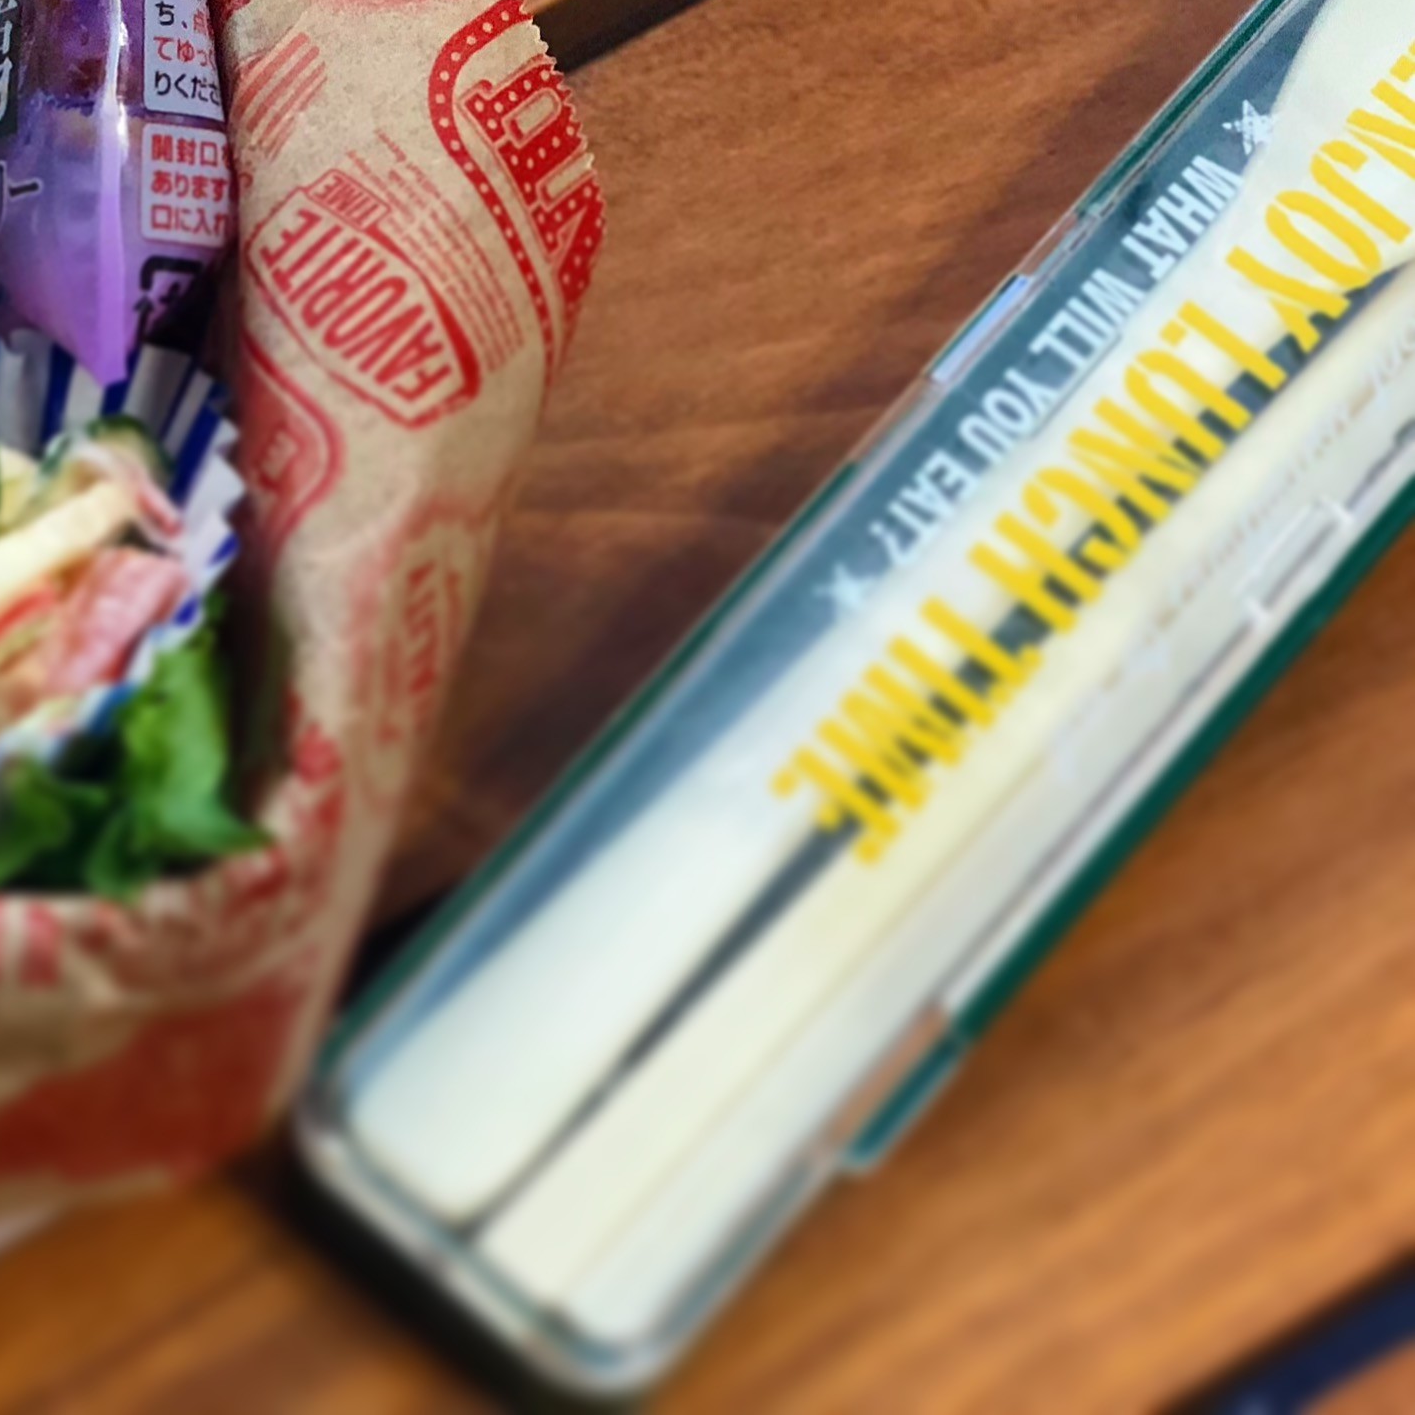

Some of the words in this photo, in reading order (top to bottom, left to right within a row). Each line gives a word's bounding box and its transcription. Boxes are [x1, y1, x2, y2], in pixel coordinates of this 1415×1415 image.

[313, 175, 383, 229] TIME
[1120, 154, 1245, 286] WHAT
[259, 208, 452, 401] FAVORITE
[1029, 274, 1138, 389] WILL
[959, 366, 1042, 475] YOU
[967, 301, 1289, 635] LUNCH
[866, 455, 980, 566] EAT?
[768, 595, 1042, 865] TIME
